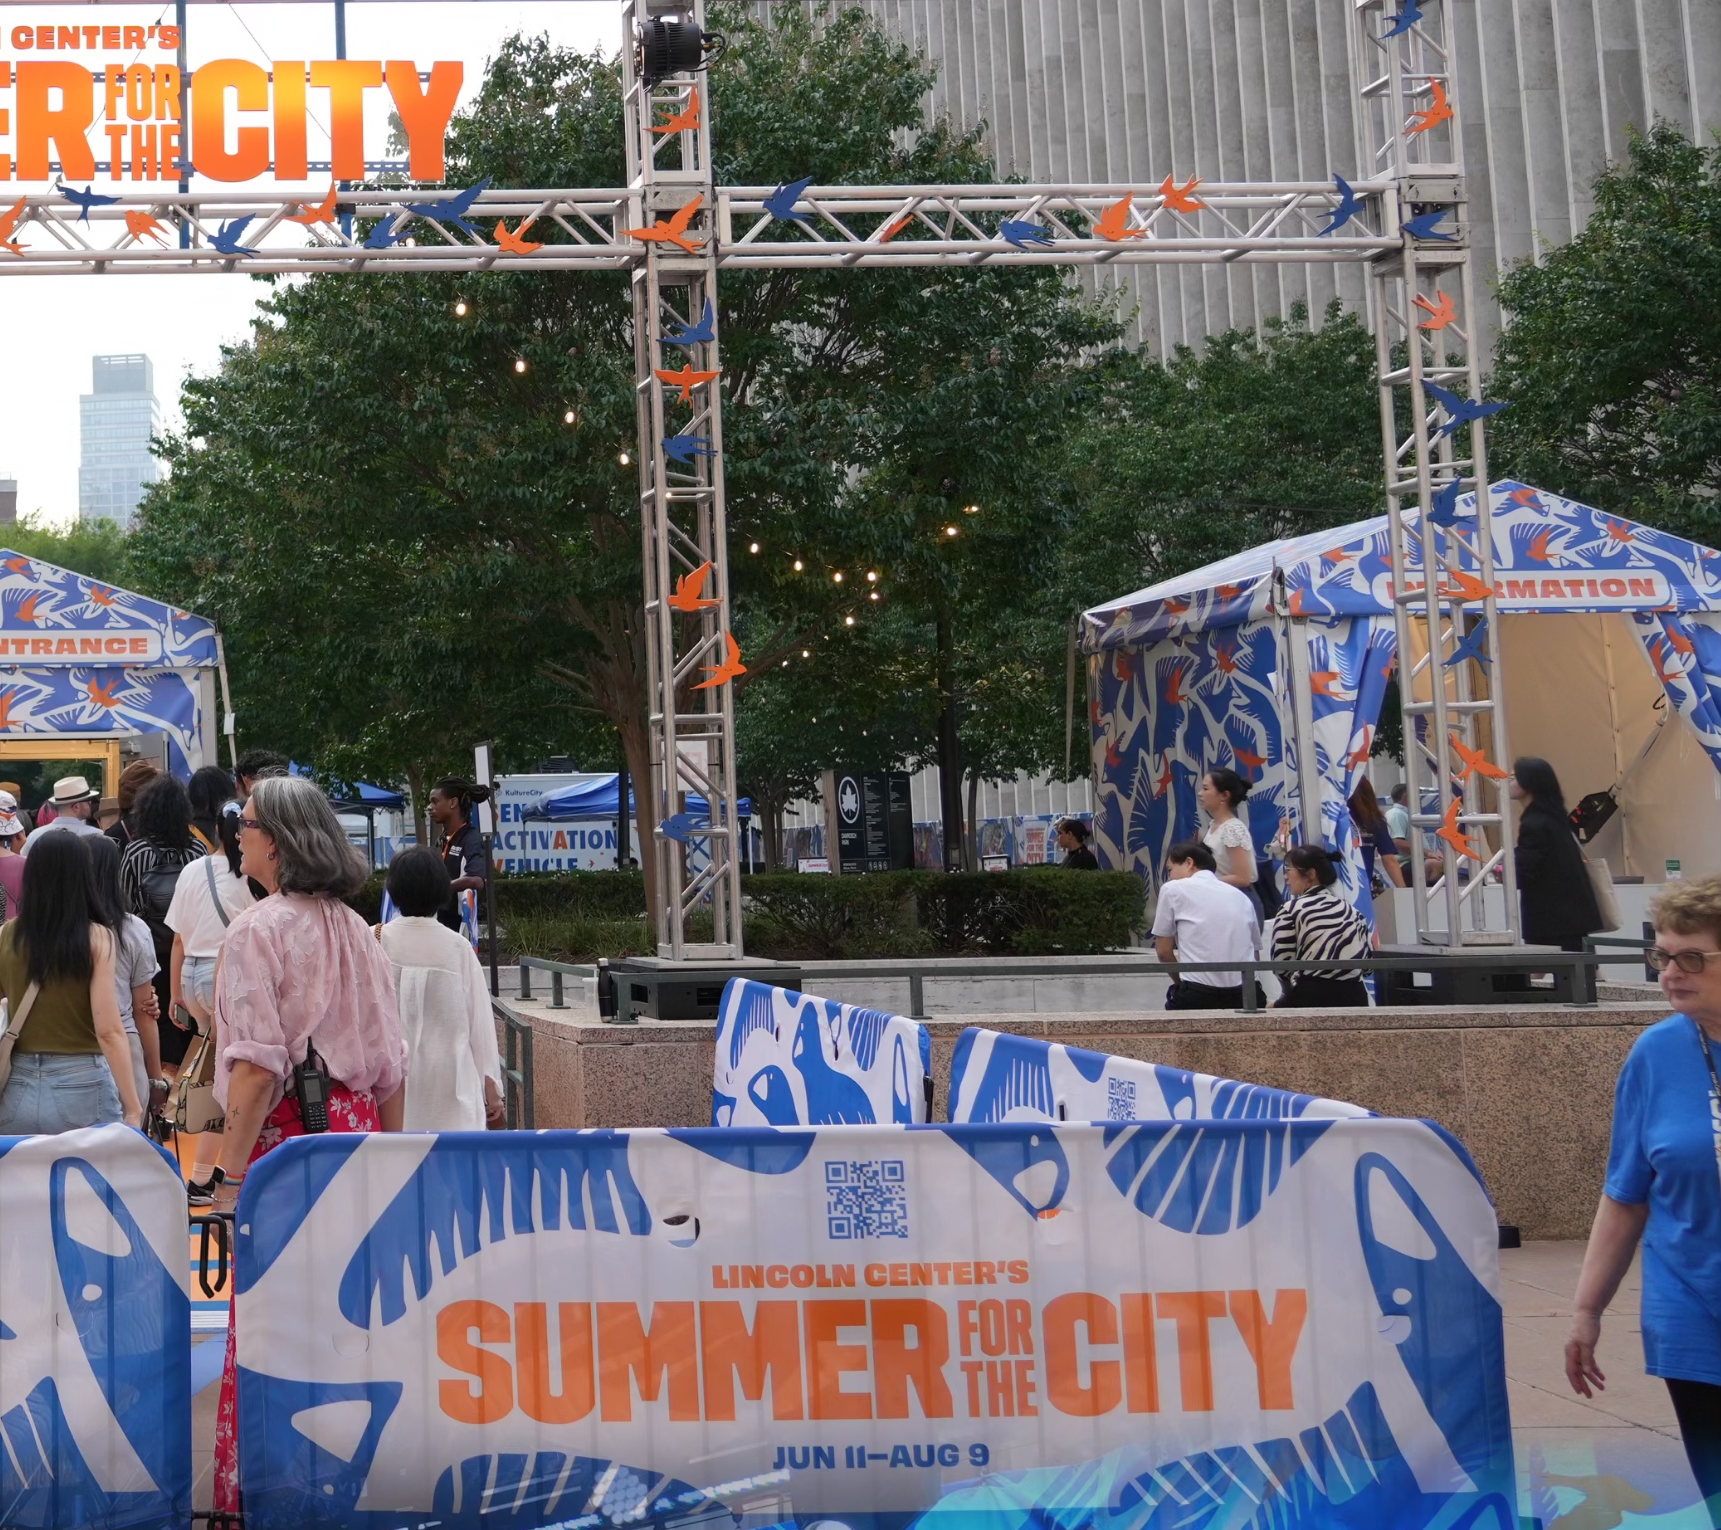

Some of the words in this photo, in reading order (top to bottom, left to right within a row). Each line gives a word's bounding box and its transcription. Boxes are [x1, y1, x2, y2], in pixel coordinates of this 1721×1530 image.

[12, 25, 181, 49] CENTER'S
[105, 63, 182, 121] FOR
[190, 58, 464, 183] CITY
[104, 123, 182, 181] THE
[504, 789, 543, 797] KultureCity
[491, 830, 617, 850] ACTIVATION
[713, 1265, 857, 1289] LINCOLN
[864, 1261, 1030, 1288] CENTER'S
[958, 1299, 1034, 1357] FOR
[1043, 1289, 1308, 1417] CITY
[437, 1298, 954, 1425] SUMMER
[961, 1360, 1039, 1418] THE
[772, 1445, 838, 1471] JUN
[967, 1442, 991, 1469] 9
